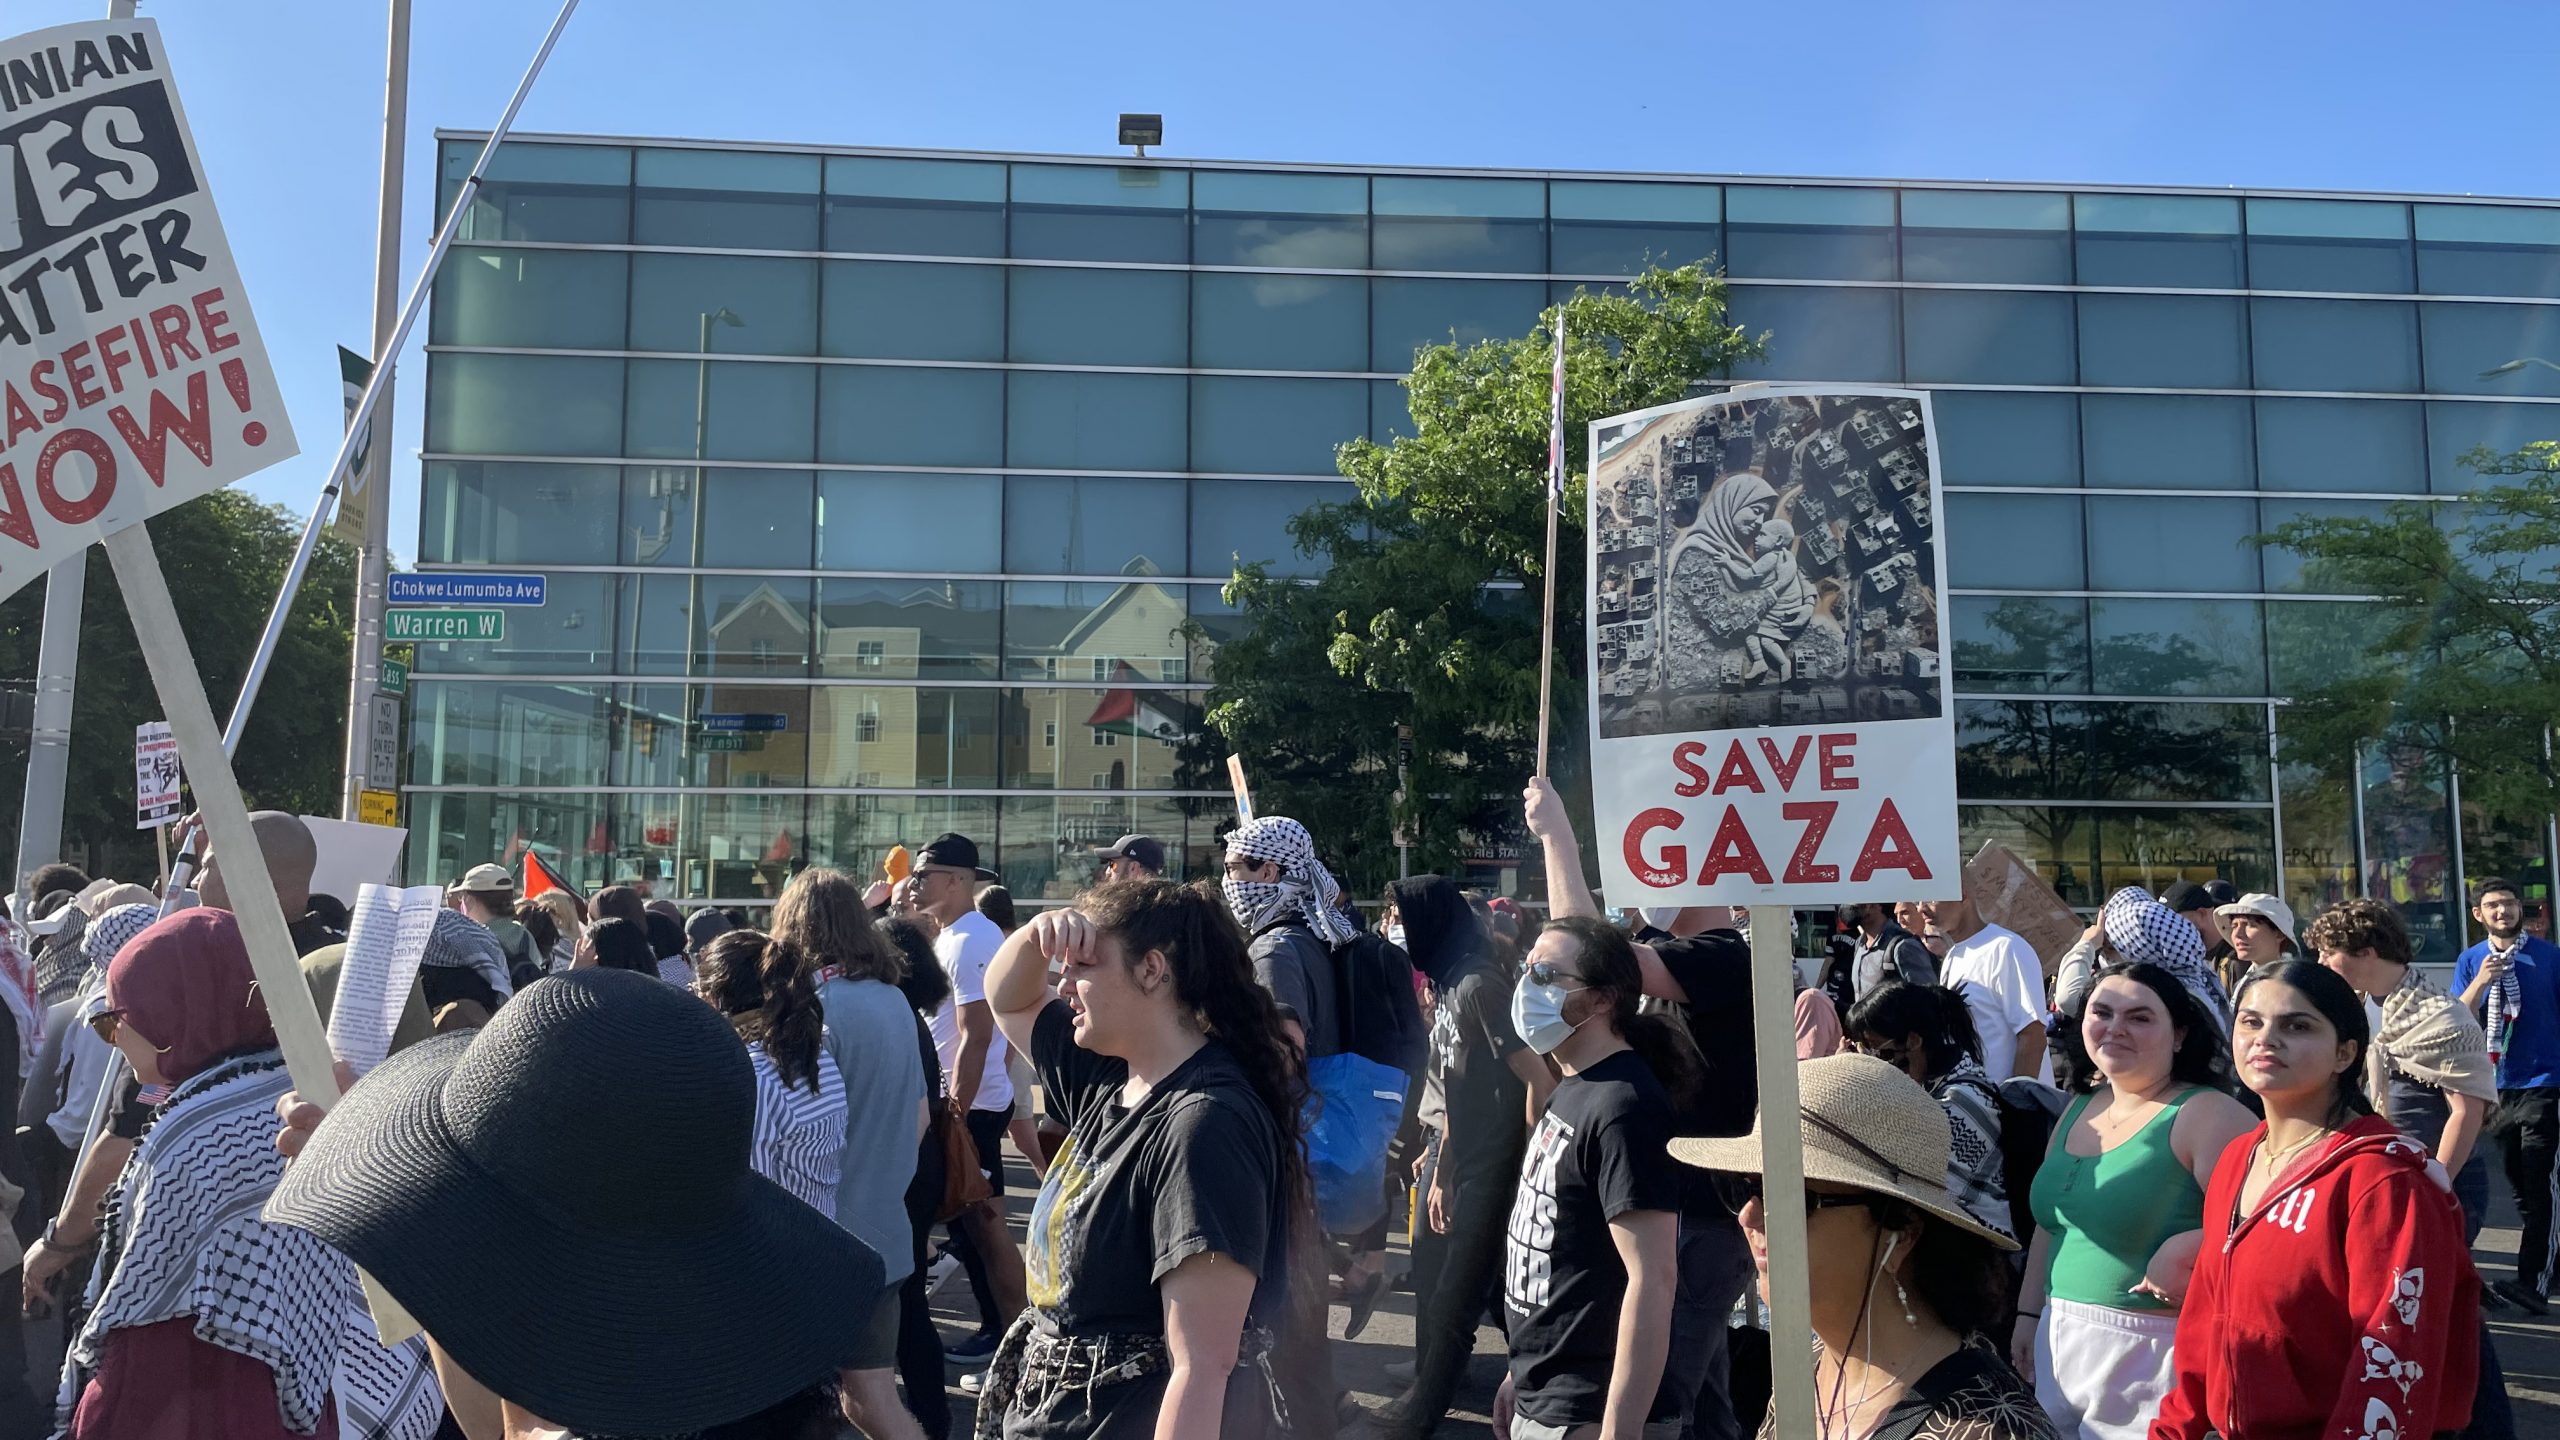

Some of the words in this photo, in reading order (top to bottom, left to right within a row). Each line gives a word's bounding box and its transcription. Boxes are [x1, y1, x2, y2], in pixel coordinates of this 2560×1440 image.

[0, 287, 240, 454] ASEFIRE
[393, 580, 444, 596] Chokwe
[447, 581, 513, 597] Lumumba
[516, 583, 541, 598] Ave
[394, 614, 468, 635] Warren
[479, 615, 496, 636] W
[382, 663, 400, 684] Cass
[380, 702, 391, 717] NO
[377, 720, 393, 736] TURN
[374, 739, 383, 753] ON
[384, 741, 395, 754] RED
[138, 757, 151, 767] STOP
[1673, 732, 1859, 797] SAVE
[140, 771, 151, 780] THE
[140, 785, 152, 794] U.S.
[140, 797, 153, 807] WAR
[1623, 797, 1933, 888] GAZA
[2122, 842, 2181, 863] WYNE
